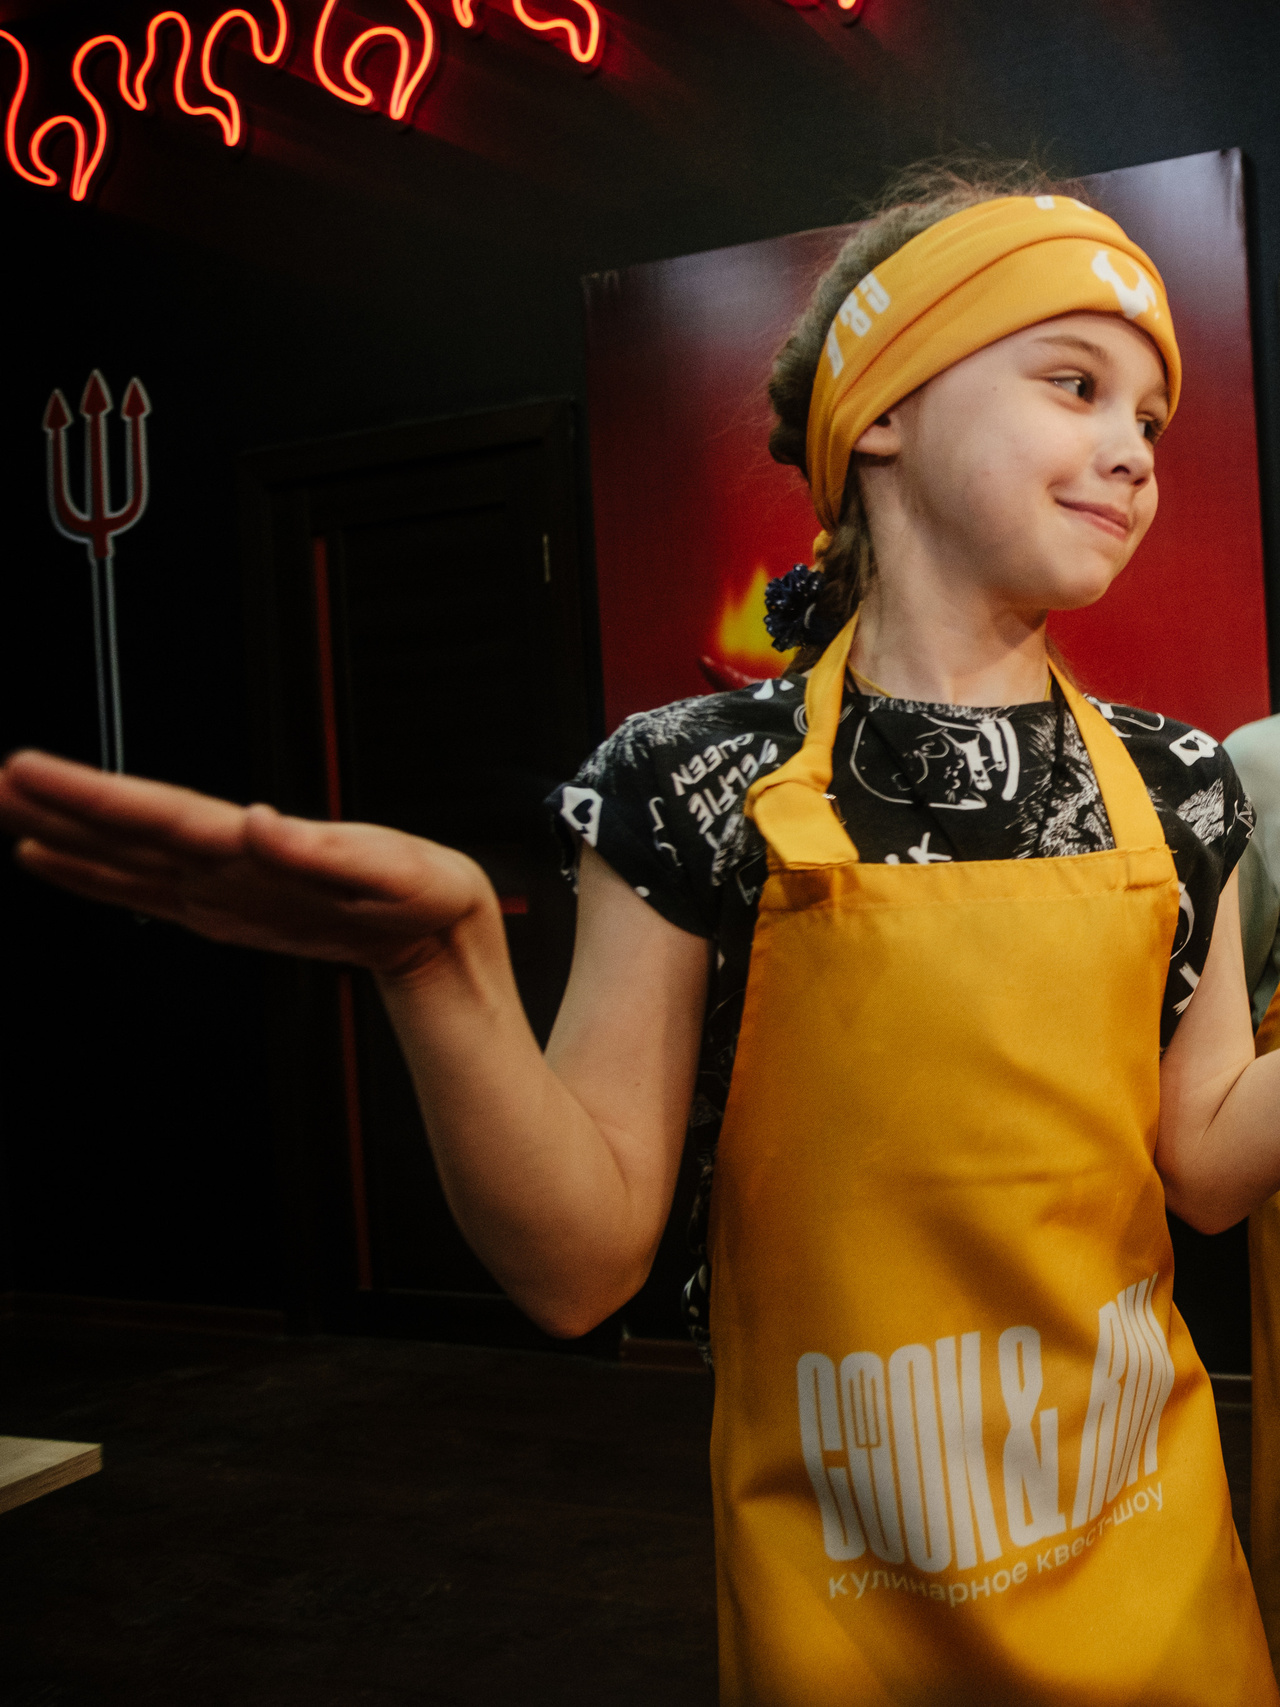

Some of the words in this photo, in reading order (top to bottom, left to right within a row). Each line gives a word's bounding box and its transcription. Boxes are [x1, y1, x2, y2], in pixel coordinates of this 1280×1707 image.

[796, 1331, 1003, 1574] COOK
[997, 1325, 1067, 1548] &
[828, 1560, 1029, 1608] кулинарное
[1035, 1481, 1164, 1572] квест-шоу
